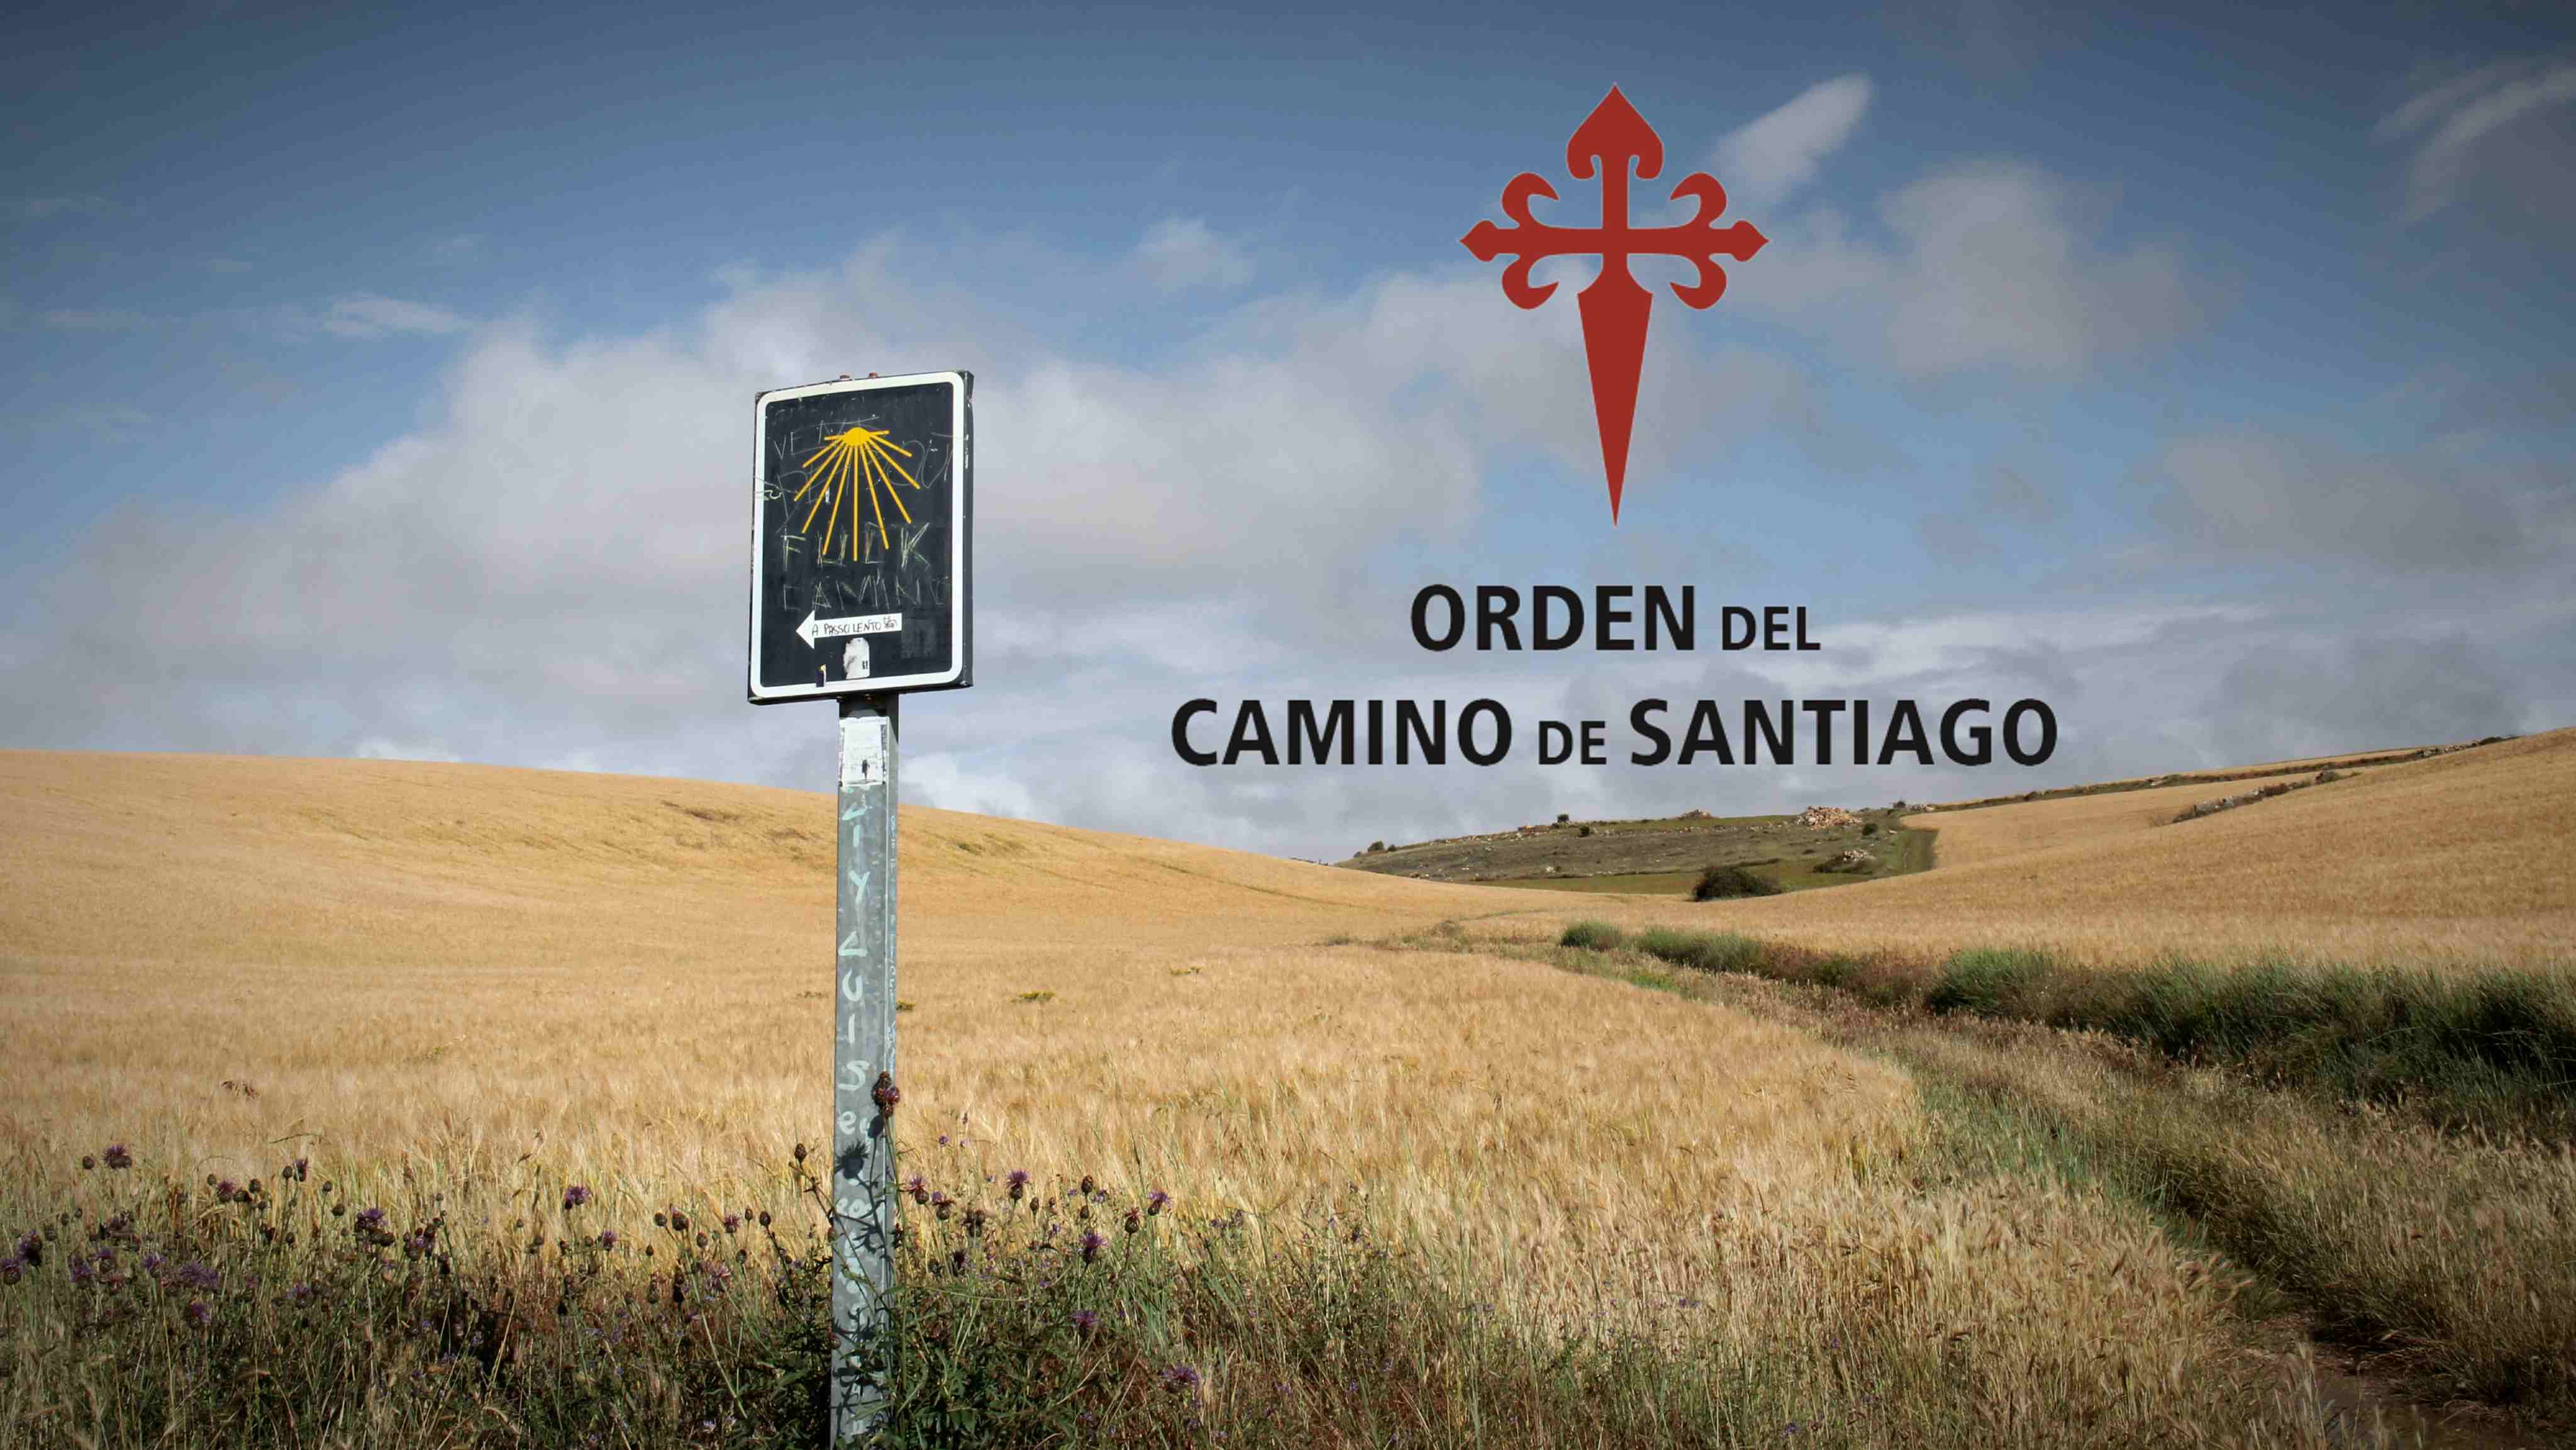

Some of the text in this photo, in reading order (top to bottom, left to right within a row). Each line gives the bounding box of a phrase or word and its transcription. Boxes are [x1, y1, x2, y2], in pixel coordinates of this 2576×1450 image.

[780, 521, 931, 572] FUCK
[811, 619, 882, 637] A PASSO LENTO
